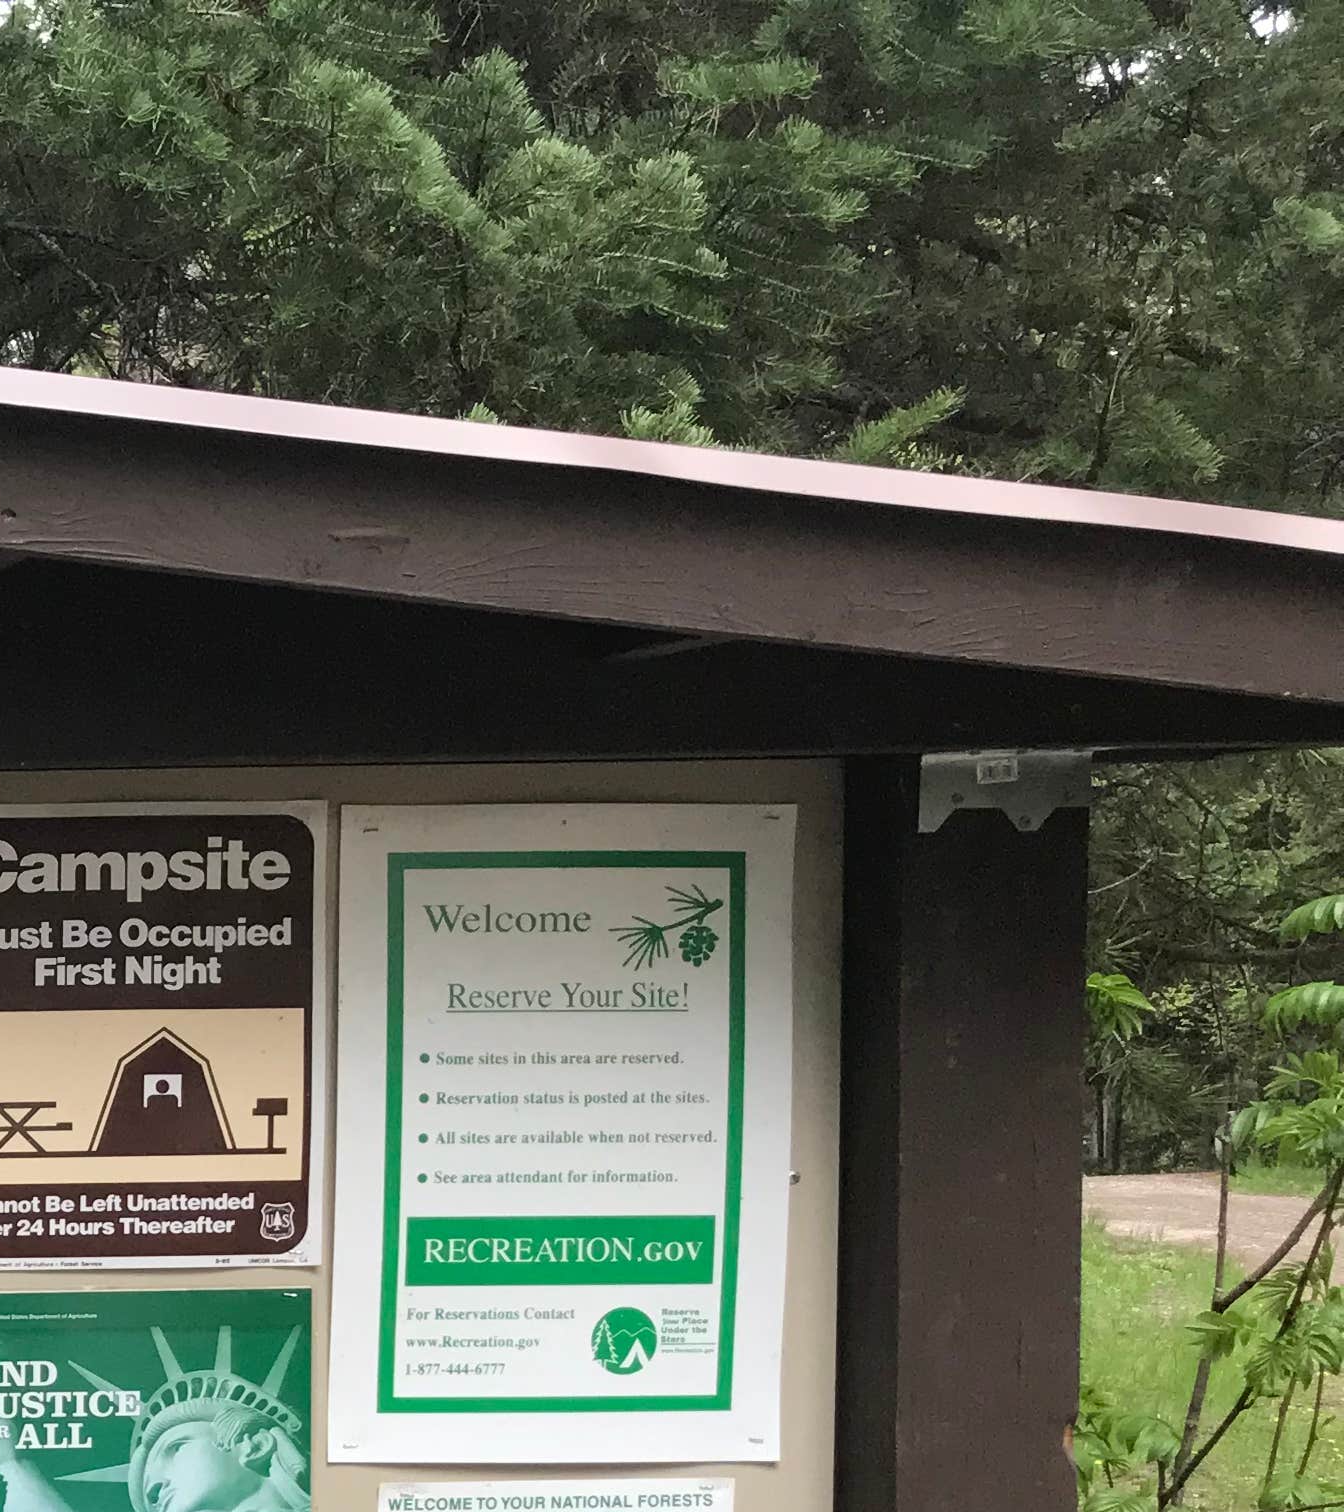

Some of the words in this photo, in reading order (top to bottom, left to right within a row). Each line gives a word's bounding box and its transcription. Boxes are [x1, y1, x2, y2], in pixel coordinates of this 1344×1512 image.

[422, 903, 591, 932] Welcome
[62, 919, 112, 947] Be
[119, 917, 291, 956] Occupied
[34, 956, 116, 986] First
[124, 955, 221, 990] Night
[447, 983, 551, 1008] Reserve
[559, 982, 623, 1007] Your
[630, 981, 688, 1007] Site!
[436, 1051, 473, 1065] Some
[478, 1052, 508, 1064] sites
[512, 1051, 526, 1064] in
[530, 1051, 556, 1064] this
[560, 1054, 591, 1064] area
[594, 1054, 617, 1064] are
[621, 1051, 684, 1064] reserved.
[436, 1091, 518, 1104] Reservation
[522, 1092, 564, 1104] status
[568, 1090, 579, 1104] is
[583, 1090, 628, 1107] posted
[632, 1092, 646, 1103] at
[650, 1090, 671, 1103] the
[674, 1090, 710, 1104] sites.
[435, 1131, 455, 1144] All
[459, 1131, 490, 1144] sites
[494, 1134, 517, 1143] are
[520, 1130, 583, 1143] available
[587, 1130, 623, 1143] when
[628, 1132, 650, 1143] not
[654, 1129, 717, 1143] reserved.
[433, 1171, 457, 1183] See
[461, 1174, 492, 1183] area
[496, 1170, 562, 1183] attendant
[567, 1170, 588, 1182] for
[592, 1169, 678, 1182] information.
[45, 1195, 74, 1212] Be
[79, 1194, 122, 1211] Left
[126, 1192, 254, 1211] Unattended
[16, 1219, 44, 1235] 24
[48, 1218, 114, 1235] Hours
[118, 1215, 235, 1234] Thereafter
[406, 1307, 430, 1321] For
[434, 1307, 520, 1320] Reservations
[523, 1307, 574, 1319] Contact
[406, 1335, 539, 1350] www.Recreation.gov
[405, 1363, 505, 1375] 1-877-444-6777
[14, 1423, 92, 1449] ALL
[387, 1495, 472, 1511] WELCOME
[476, 1496, 497, 1510] TO
[500, 1496, 545, 1509] YOUR
[550, 1495, 632, 1508] NATIONAL
[637, 1493, 712, 1507] FORESTS
